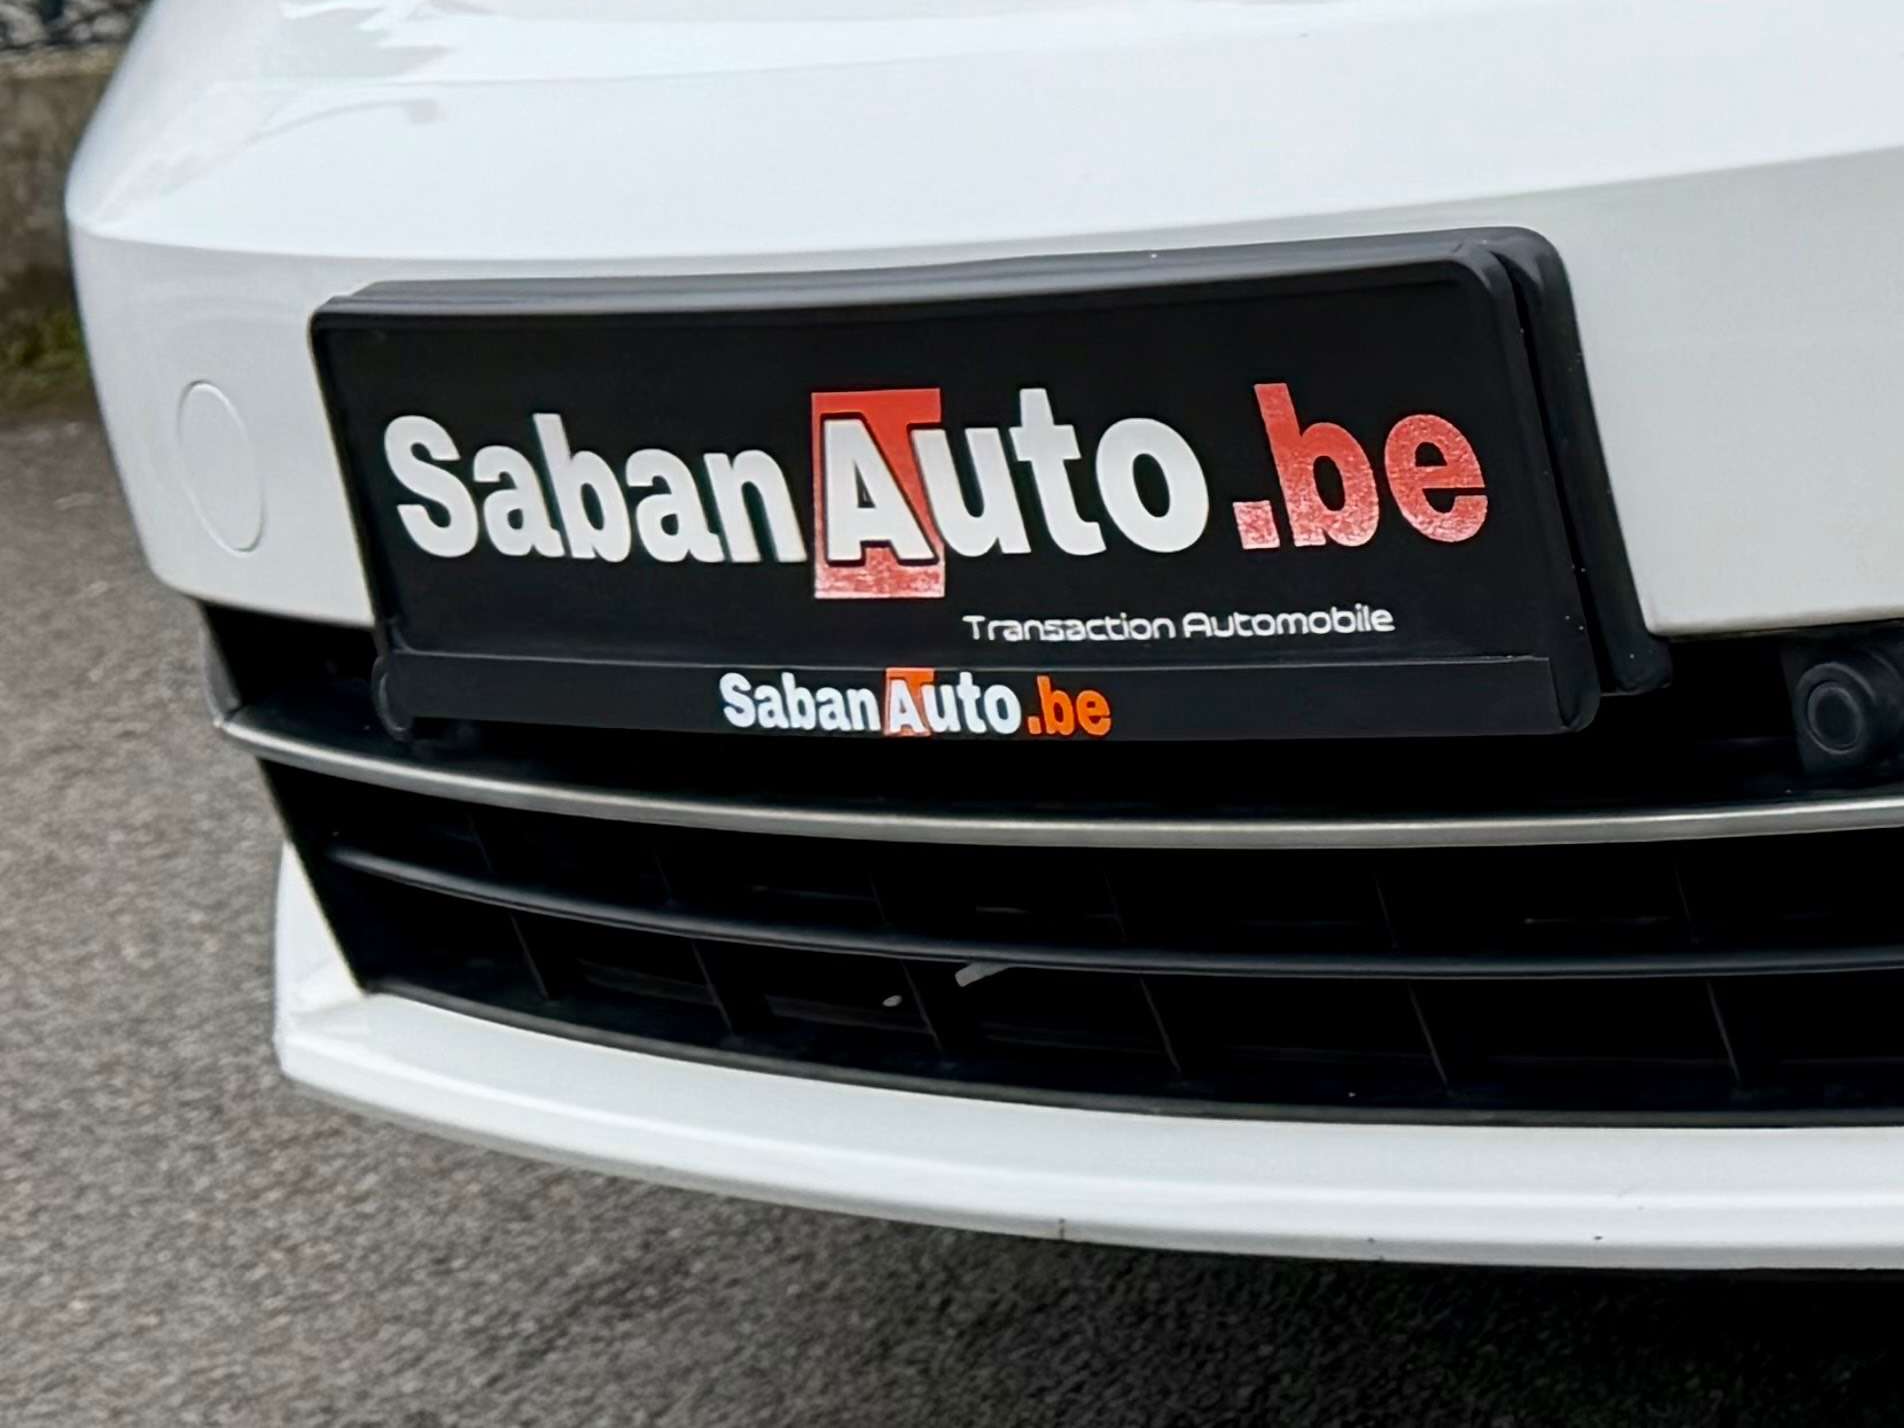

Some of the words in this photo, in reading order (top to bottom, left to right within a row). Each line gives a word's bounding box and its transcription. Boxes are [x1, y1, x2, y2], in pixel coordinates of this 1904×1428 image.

[383, 382, 1490, 567] SabanAuto.be
[963, 610, 1176, 643] Transaction
[1182, 603, 1396, 639] Automobile
[720, 671, 1113, 738] SabanAuto.be
